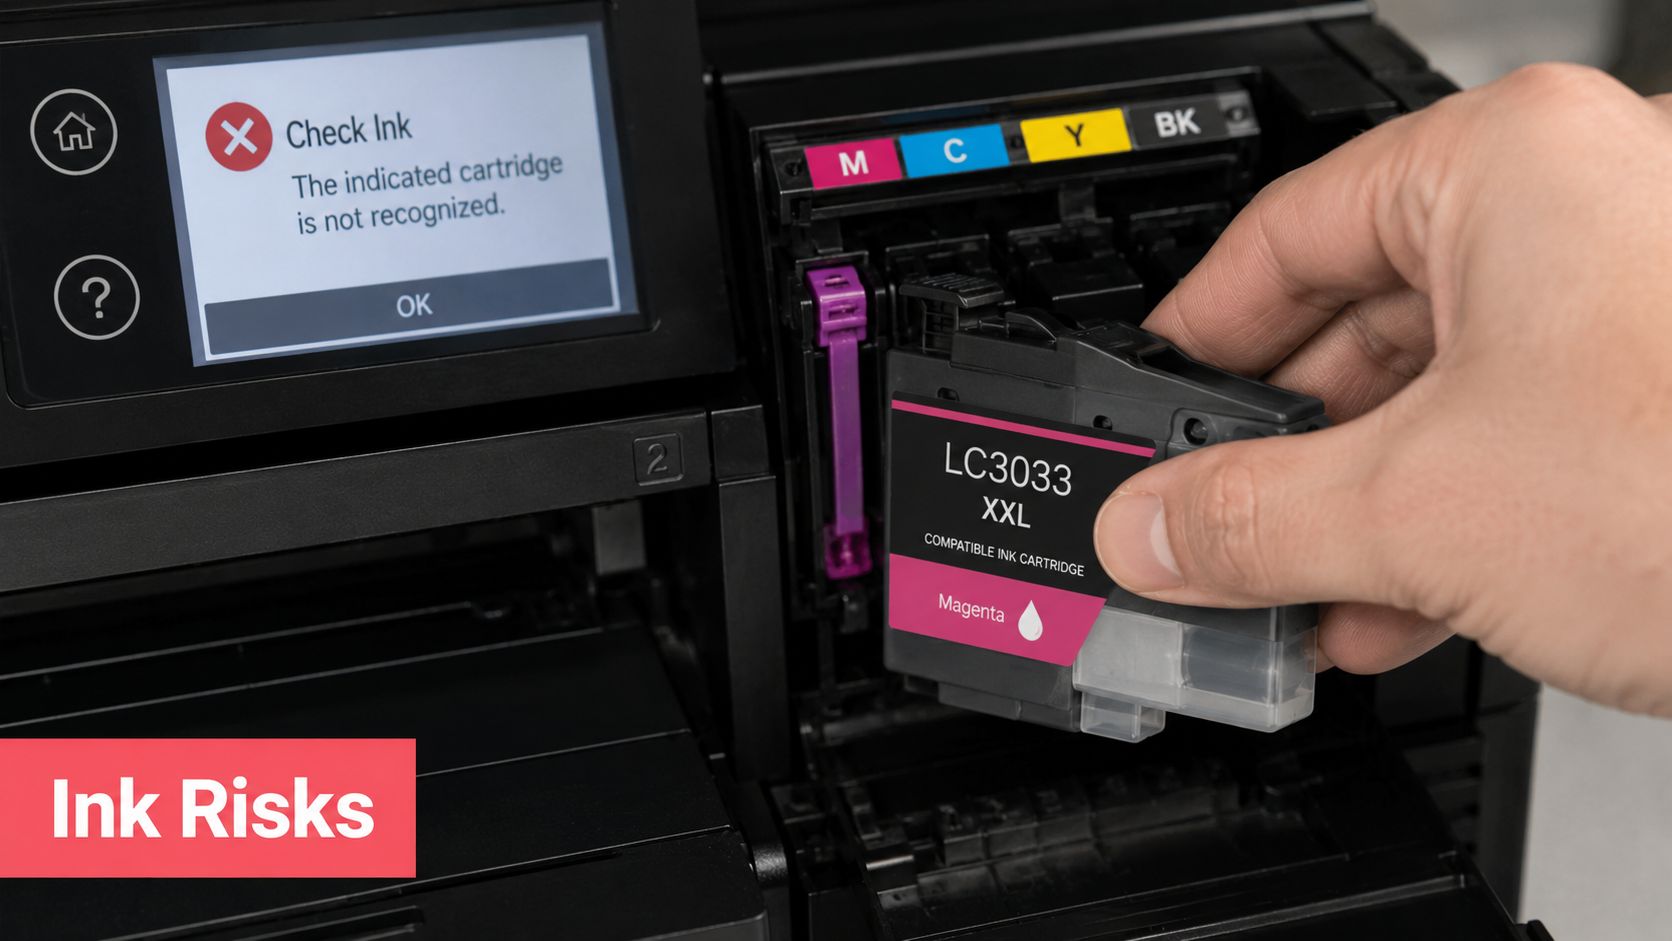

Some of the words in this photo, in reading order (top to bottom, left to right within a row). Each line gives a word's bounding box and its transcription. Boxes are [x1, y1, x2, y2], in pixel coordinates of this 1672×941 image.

[286, 115, 368, 149] Check
[374, 112, 413, 141] Ink
[1064, 123, 1085, 148] Y
[1154, 108, 1200, 138] BK
[838, 150, 869, 177] M
[943, 137, 968, 164] C
[291, 173, 338, 199] The
[344, 161, 452, 194] indicated
[459, 153, 563, 183] cartridge
[297, 211, 317, 235] is
[324, 207, 364, 232] not
[370, 191, 506, 228] recognized.
[396, 292, 433, 319] OK
[647, 443, 668, 475] 2
[944, 442, 1073, 497] LC3033
[981, 495, 1032, 529] XXL
[924, 532, 995, 558] COMPATIBLE
[997, 548, 1017, 563] INK
[1019, 552, 1085, 577] CARTRIDGE
[938, 593, 1005, 623] Magenta
